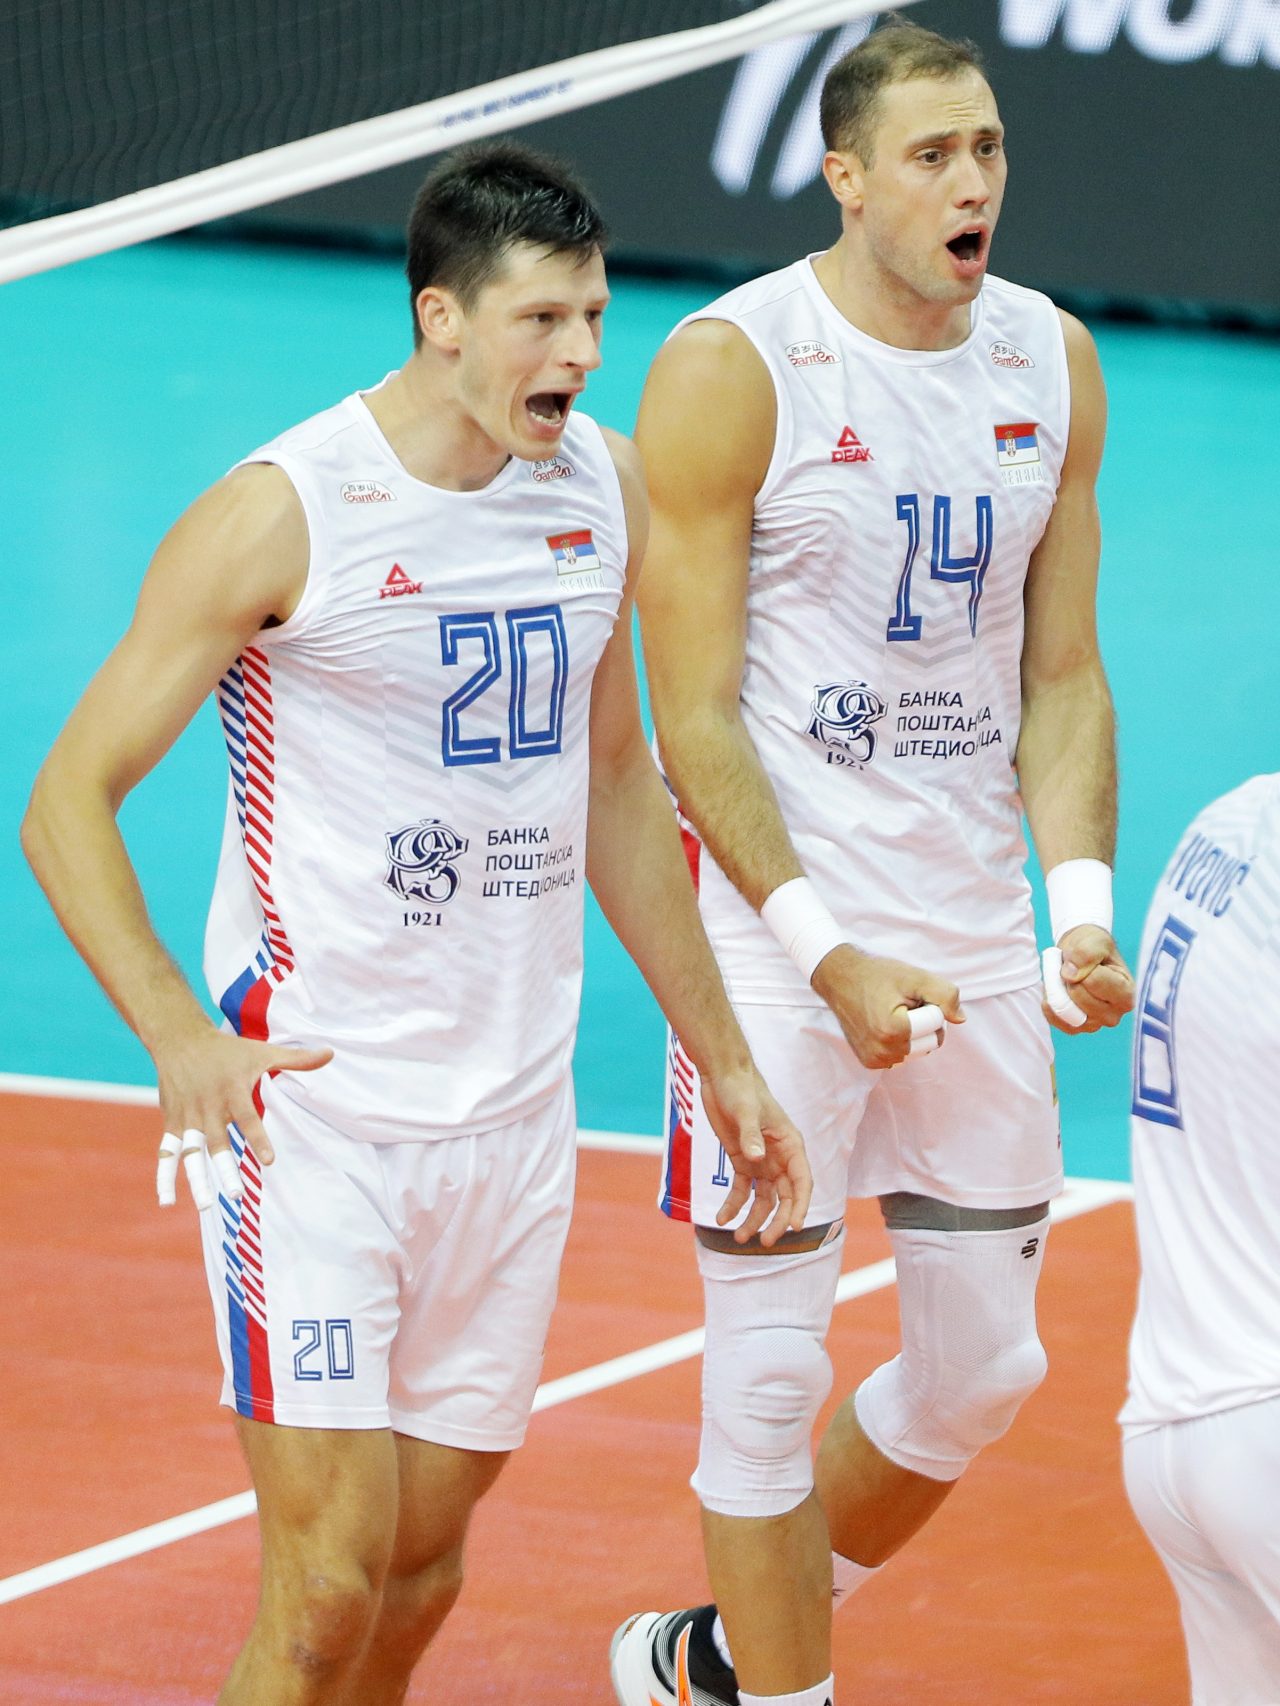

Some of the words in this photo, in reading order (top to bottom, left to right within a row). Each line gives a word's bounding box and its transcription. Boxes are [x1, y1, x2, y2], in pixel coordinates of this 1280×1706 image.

[831, 447, 875, 463] PEAK
[886, 494, 995, 642] 14
[379, 581, 423, 599] PEAK
[438, 604, 569, 767] 20
[898, 691, 964, 708] БАНКА
[897, 706, 992, 732] ПОШТАНКА
[894, 728, 1002, 759] ШТЕДИОЦА
[487, 827, 550, 846] БАНКА
[485, 845, 573, 872] ПОШТАНСКА
[482, 868, 575, 900] ШТЕДИОНИЦА
[402, 912, 442, 927] 1921
[1131, 913, 1198, 1131] 8
[292, 1319, 355, 1381] 20
